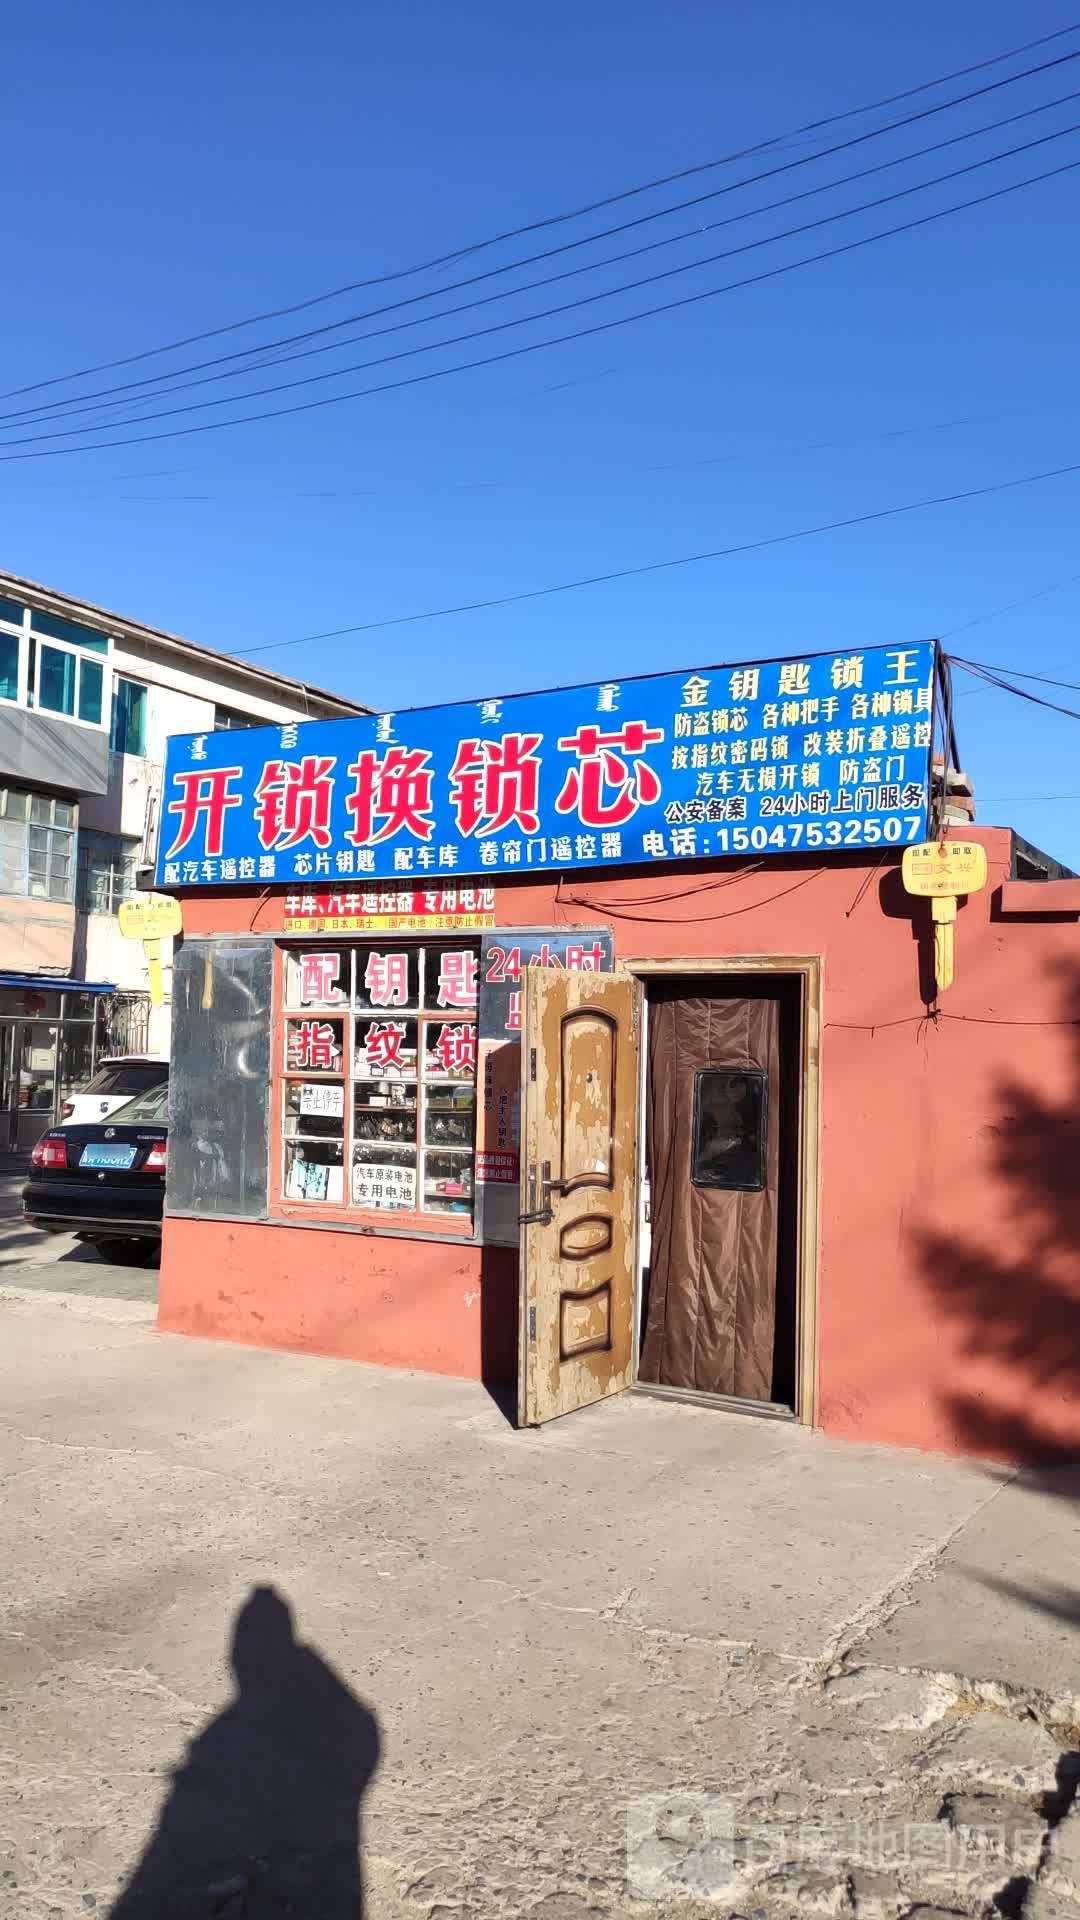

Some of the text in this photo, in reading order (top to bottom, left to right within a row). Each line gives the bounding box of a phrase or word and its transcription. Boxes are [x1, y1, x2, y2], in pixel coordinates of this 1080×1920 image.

[680, 650, 920, 707] 金钥匙锁王
[674, 687, 933, 738] 防盗锁芯 各种把手 各种锁具
[671, 721, 931, 770] 按指纹密码锁 改装折叠遥控
[165, 720, 665, 859] 开锁换锁芯
[695, 755, 904, 796] 汽车无损开锁 防盗门
[664, 783, 924, 825] 公安备案 24小时上门服务
[164, 832, 622, 884] 配汽车遥控器 芯片钥匙 配车库 卷帘门遥控器
[295, 1021, 477, 1073] 指纹锁
[356, 1168, 413, 1184] 汽车原装电池
[356, 1183, 412, 1200] 专用电池
